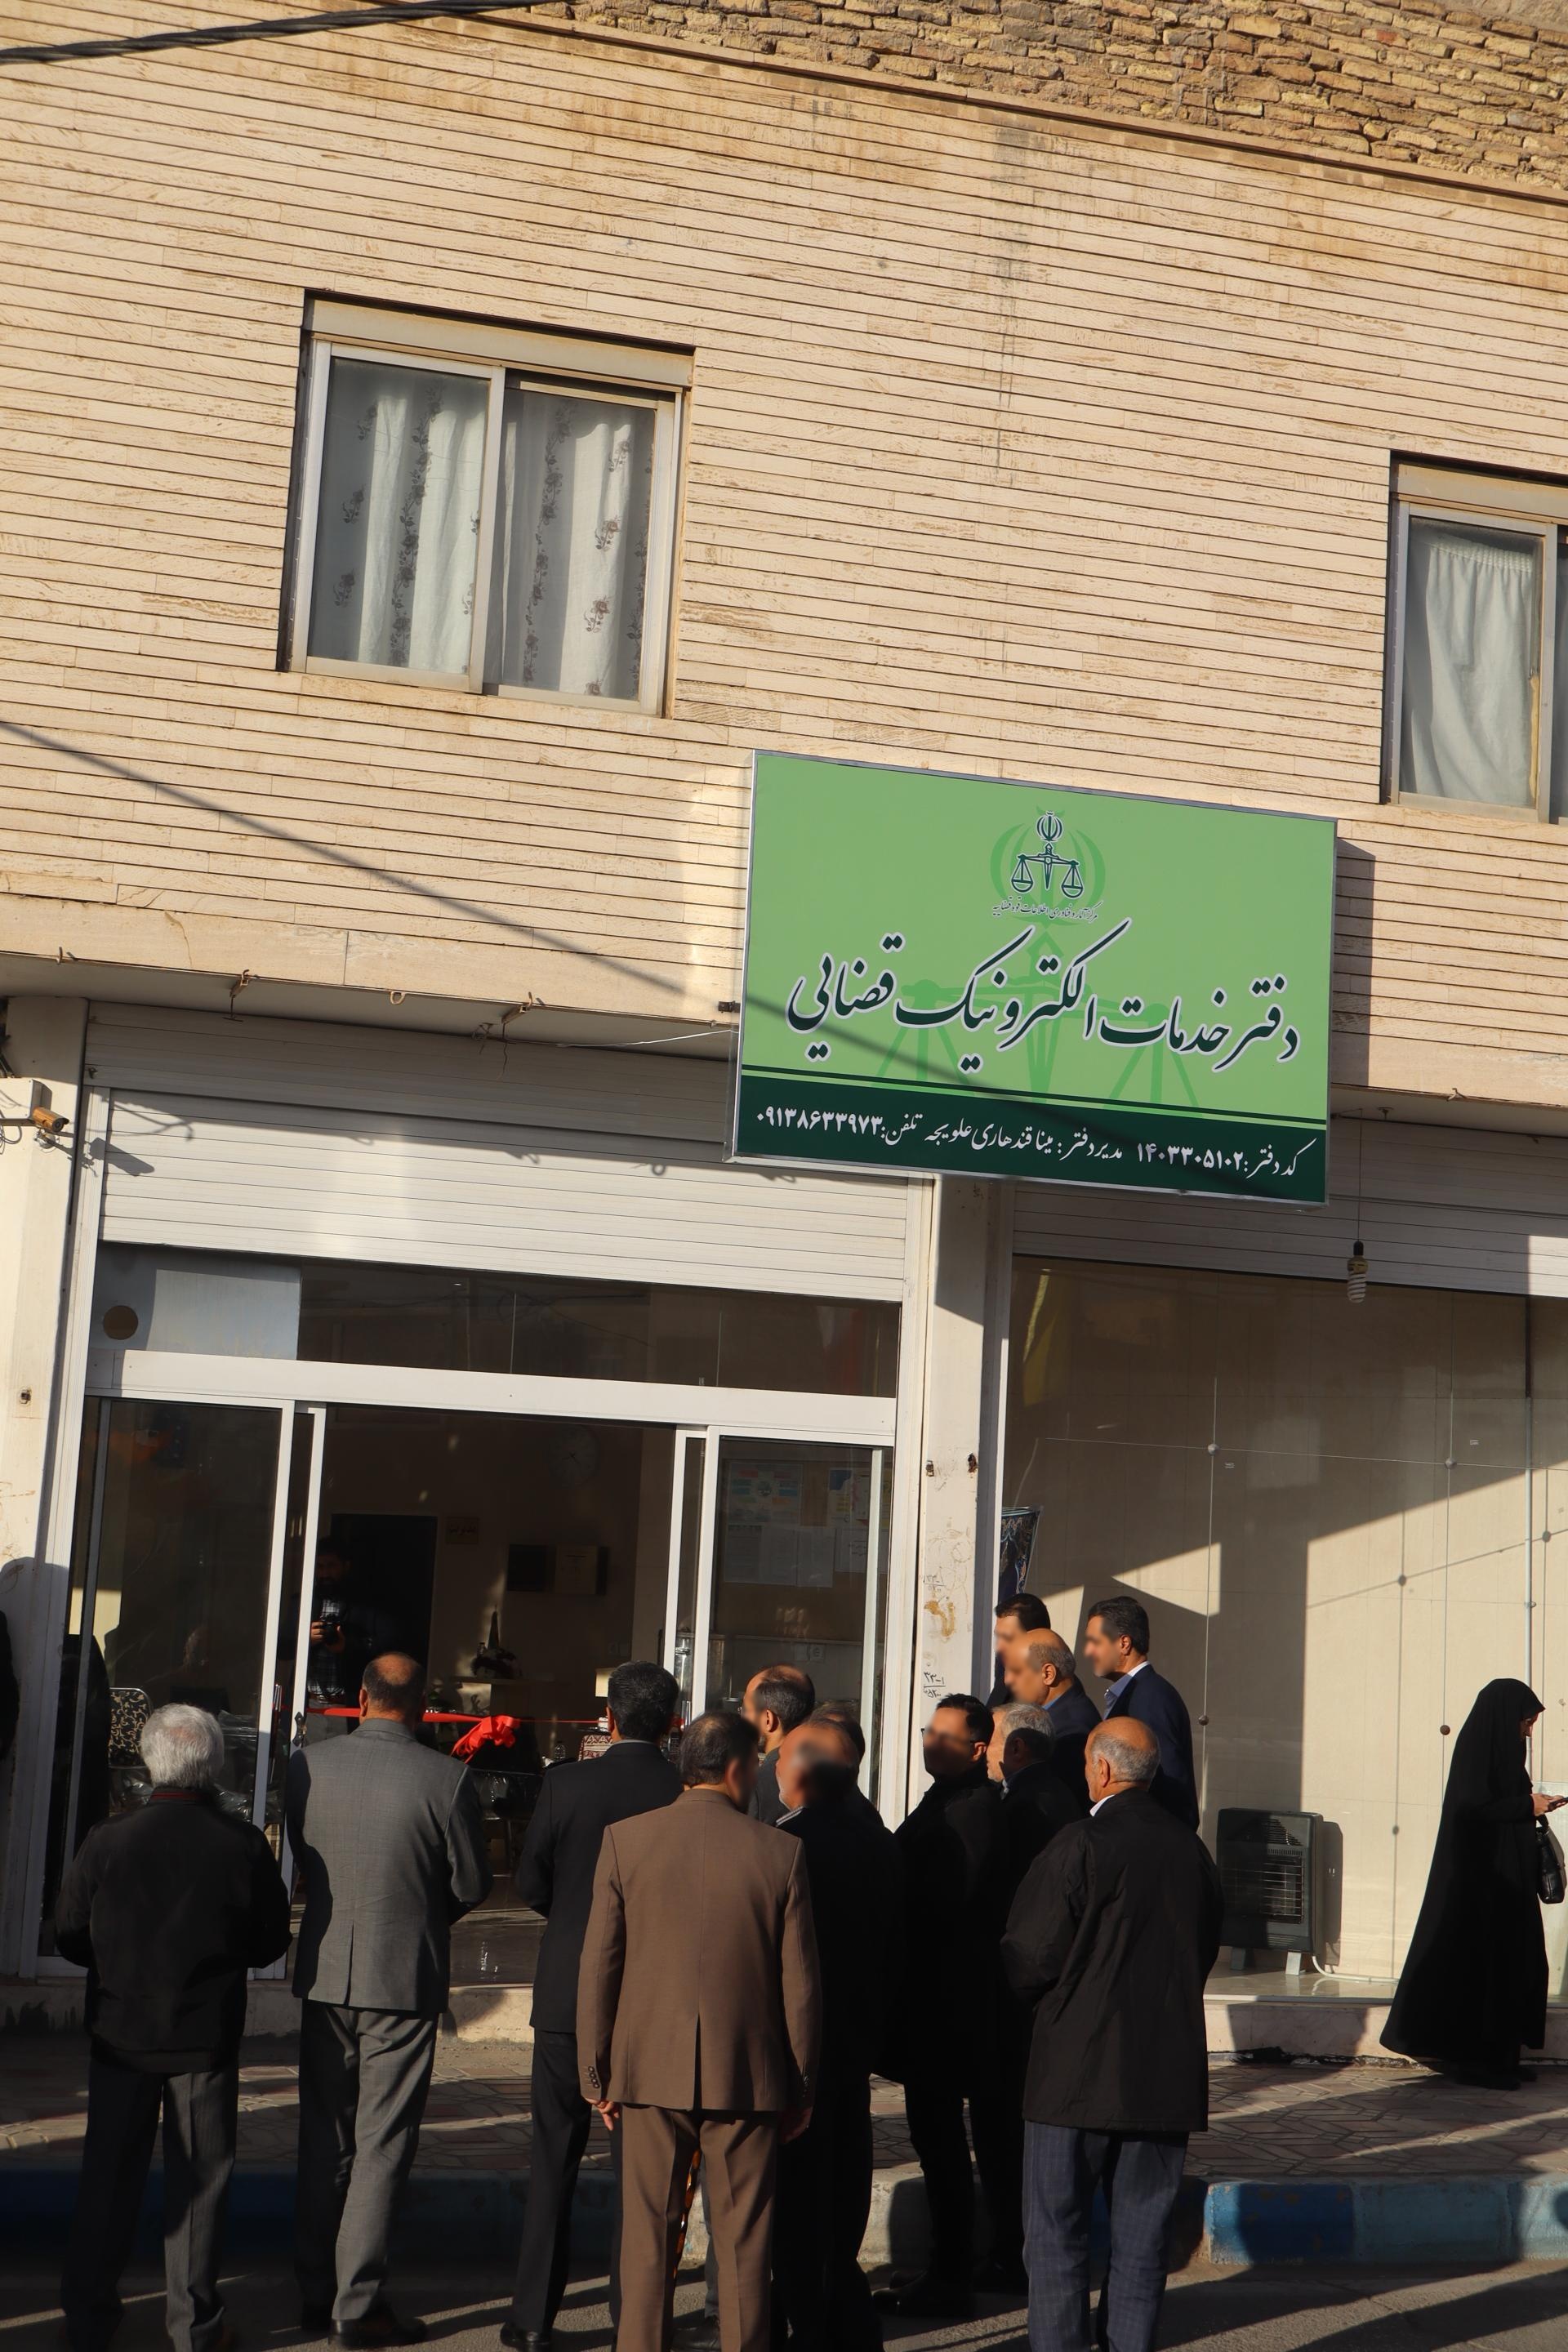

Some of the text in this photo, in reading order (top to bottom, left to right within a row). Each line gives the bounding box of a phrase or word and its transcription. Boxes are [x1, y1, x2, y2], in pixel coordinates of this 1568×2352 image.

[1020, 903, 1049, 915] اطلاعات
[1086, 901, 1102, 923] مرکز
[786, 920, 1298, 1072] دفتر خدمات الکترونیک قضایی
[756, 1106, 884, 1135] ۰۹۱۳۸۶۳۳۹۷۳
[924, 1117, 973, 1146] علویجه
[971, 1123, 1033, 1151] قندهاری
[1036, 1129, 1054, 1154] مینا
[1094, 1143, 1123, 1160] مدیر
[1137, 1143, 1244, 1171] ۱۴۰۳۳۰۵۱۰۲
[1280, 1138, 1317, 1176] کد
